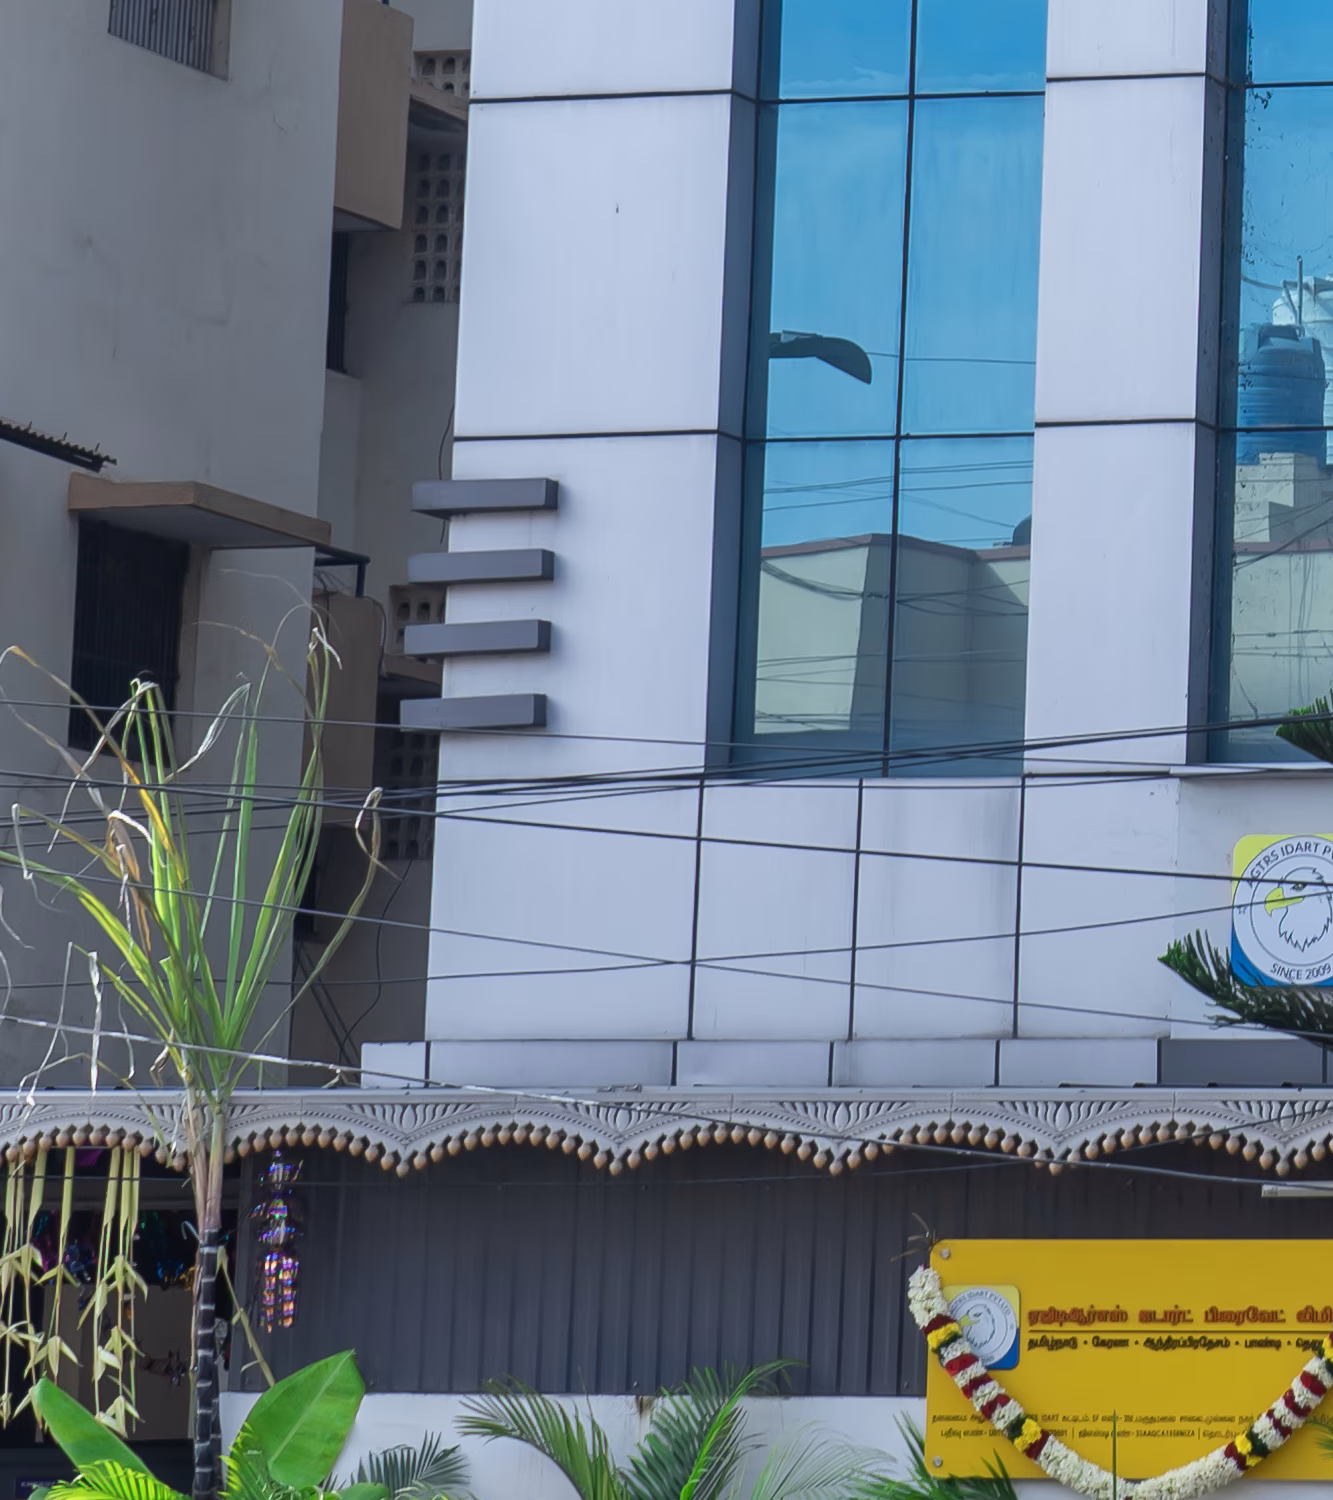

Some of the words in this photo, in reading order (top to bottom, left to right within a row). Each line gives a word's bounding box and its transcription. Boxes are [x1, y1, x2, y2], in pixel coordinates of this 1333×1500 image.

[1280, 841, 1322, 858] IDART
[1269, 962, 1303, 981] SINCE
[1304, 962, 1333, 980] 2009
